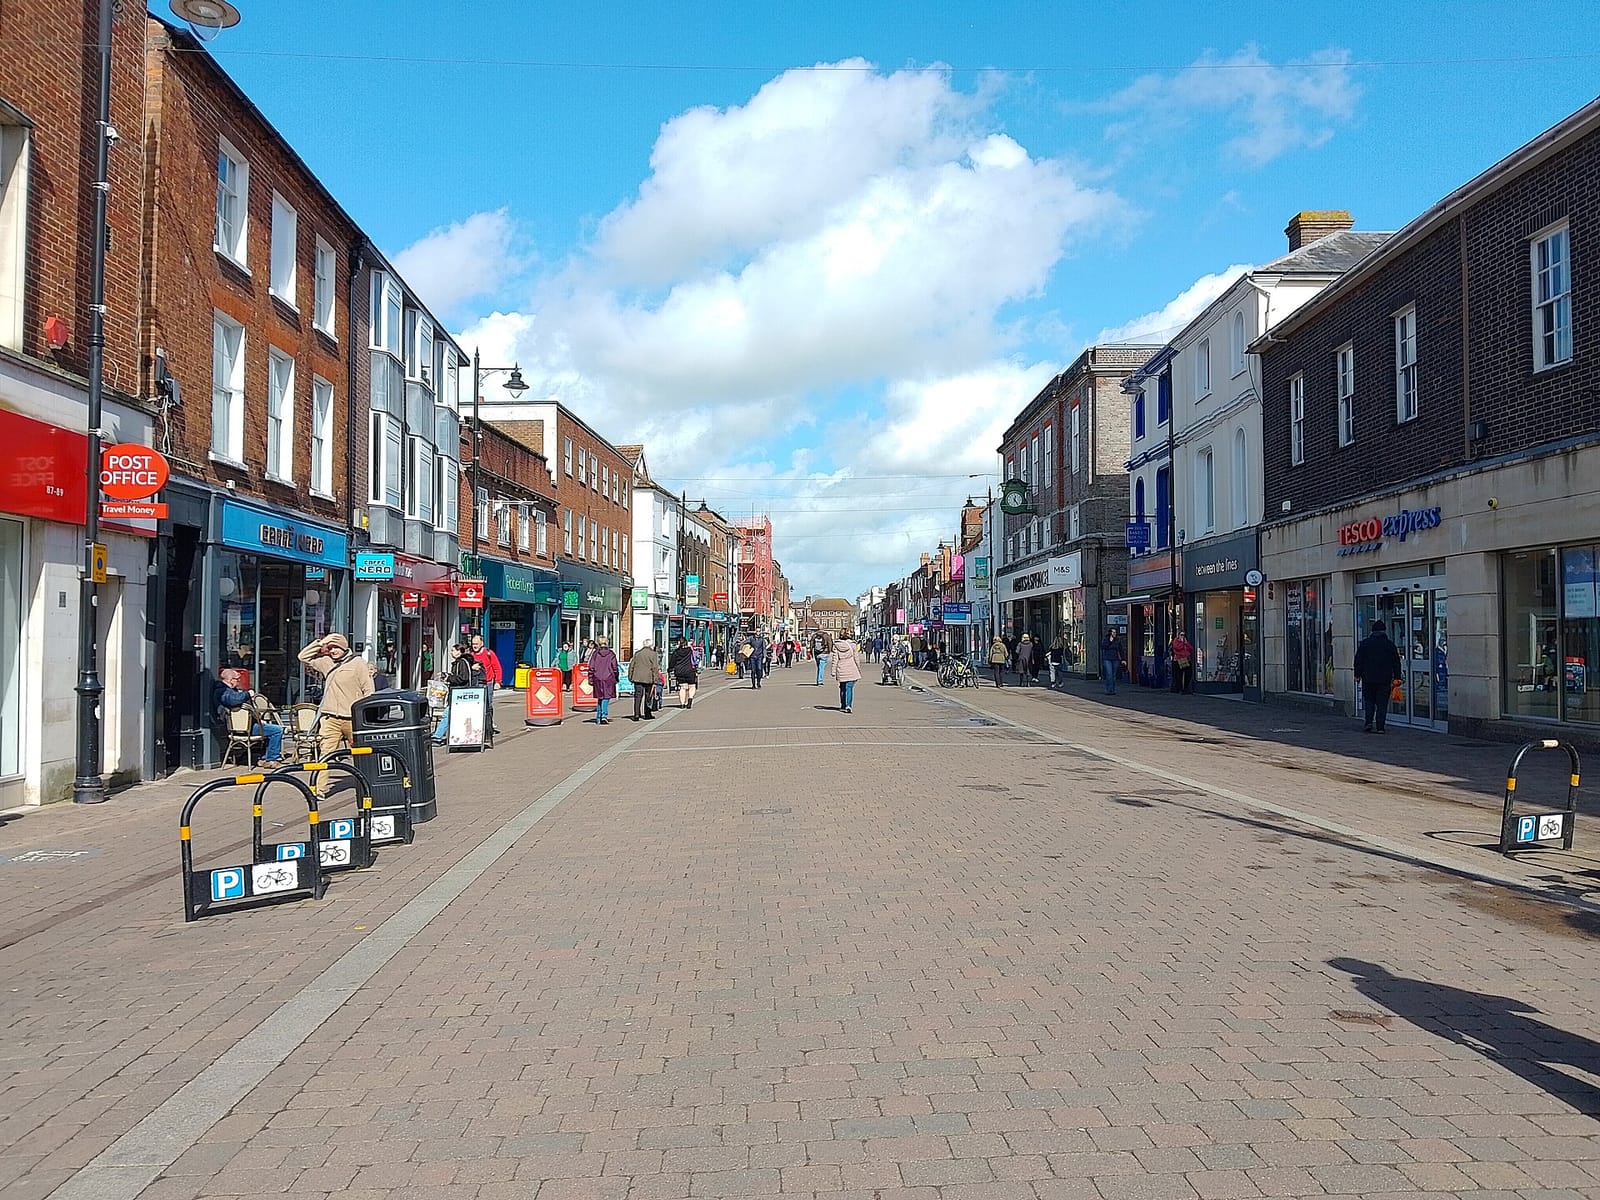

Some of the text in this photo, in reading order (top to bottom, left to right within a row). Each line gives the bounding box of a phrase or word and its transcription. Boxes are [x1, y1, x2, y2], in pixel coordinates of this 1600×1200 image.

[109, 455, 152, 469] POST
[100, 471, 157, 485] OFFICE
[46, 485, 64, 497] 87-89
[102, 505, 155, 514] Travel Money
[1337, 507, 1440, 545] TESCO express
[296, 534, 323, 555] NERO
[1195, 563, 1215, 576] between
[1216, 559, 1224, 573] the
[372, 733, 397, 741] LITTER
[1521, 818, 1533, 840] P
[217, 871, 239, 898] P
